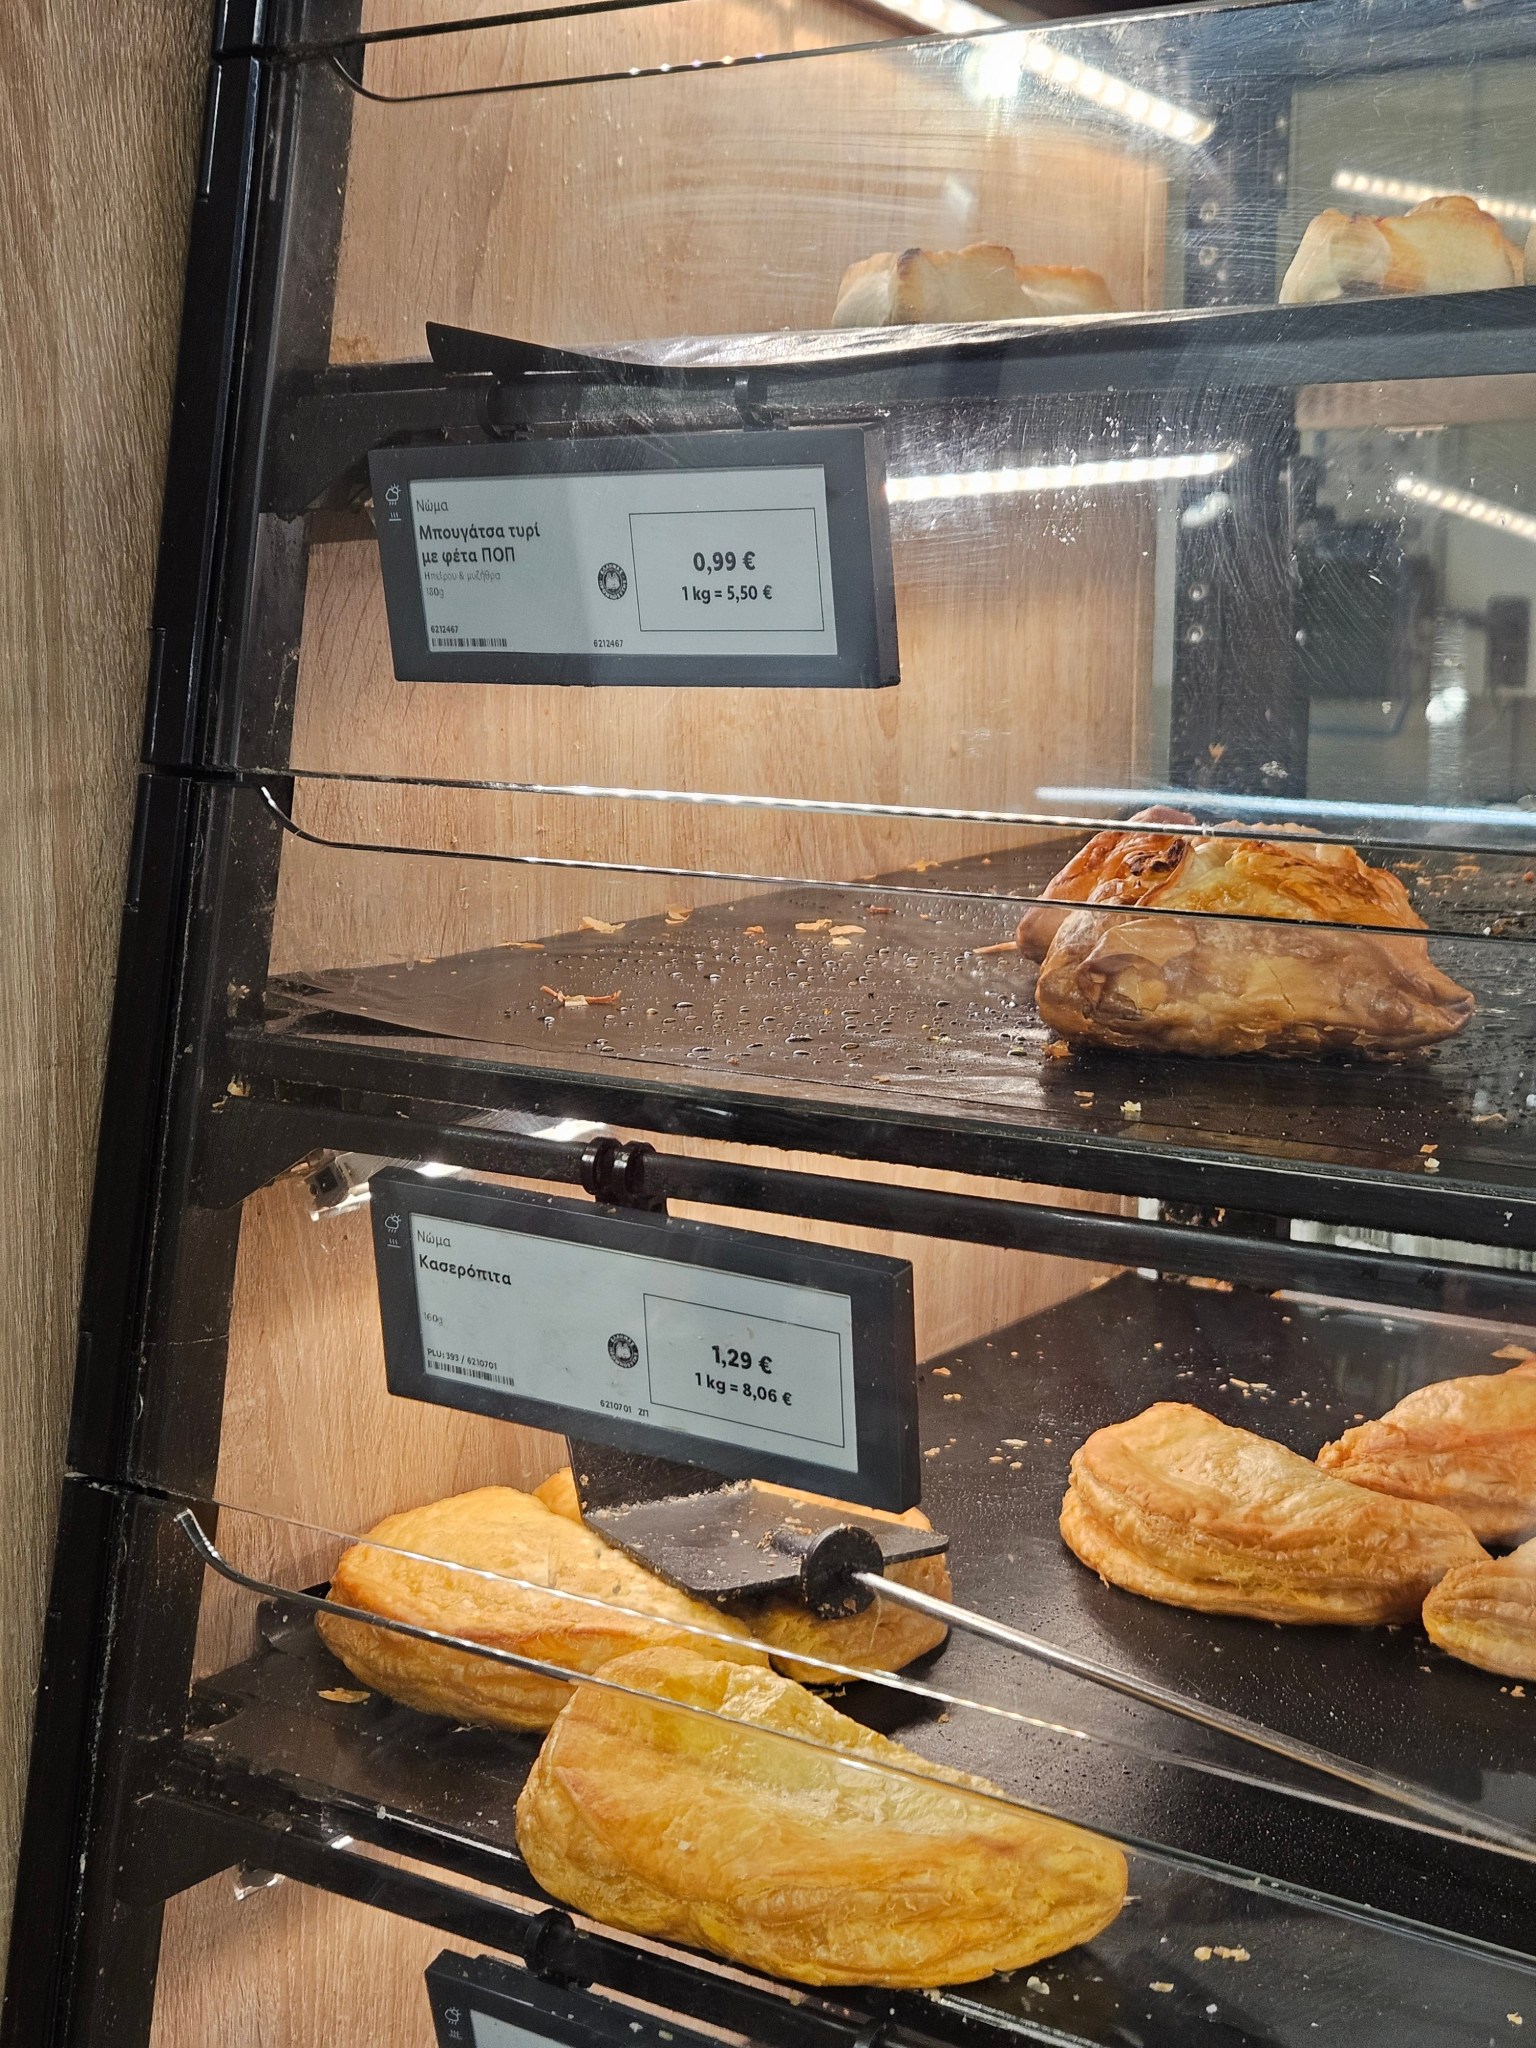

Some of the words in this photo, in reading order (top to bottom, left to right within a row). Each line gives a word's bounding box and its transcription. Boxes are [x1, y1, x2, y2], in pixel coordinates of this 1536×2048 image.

[416, 499, 449, 513] Νώμα
[418, 523, 506, 543] Μπουγάτσα
[508, 521, 541, 543] τυρί
[421, 549, 439, 567] με
[442, 547, 478, 567] φέτα
[481, 546, 516, 563] ΠΟΠ
[692, 550, 737, 575] 0,99
[742, 550, 756, 571] €
[458, 571, 464, 580] &
[681, 586, 689, 601] 1
[692, 585, 711, 604] kg
[726, 585, 758, 603] 5,50
[762, 584, 773, 600] €
[430, 625, 459, 634] 6212467
[593, 639, 624, 648] 6212467
[417, 1230, 452, 1249] Νώμα
[418, 1254, 512, 1286] Κασερόπιτα
[467, 1356, 498, 1370] 6210701
[711, 1345, 752, 1370] 1,29
[758, 1355, 773, 1375] €
[694, 1372, 702, 1386] 1
[706, 1374, 726, 1395] kg
[729, 1383, 739, 1392] =
[742, 1383, 778, 1402] 8,06
[782, 1392, 793, 1406] €
[599, 1399, 632, 1413] 6210701
